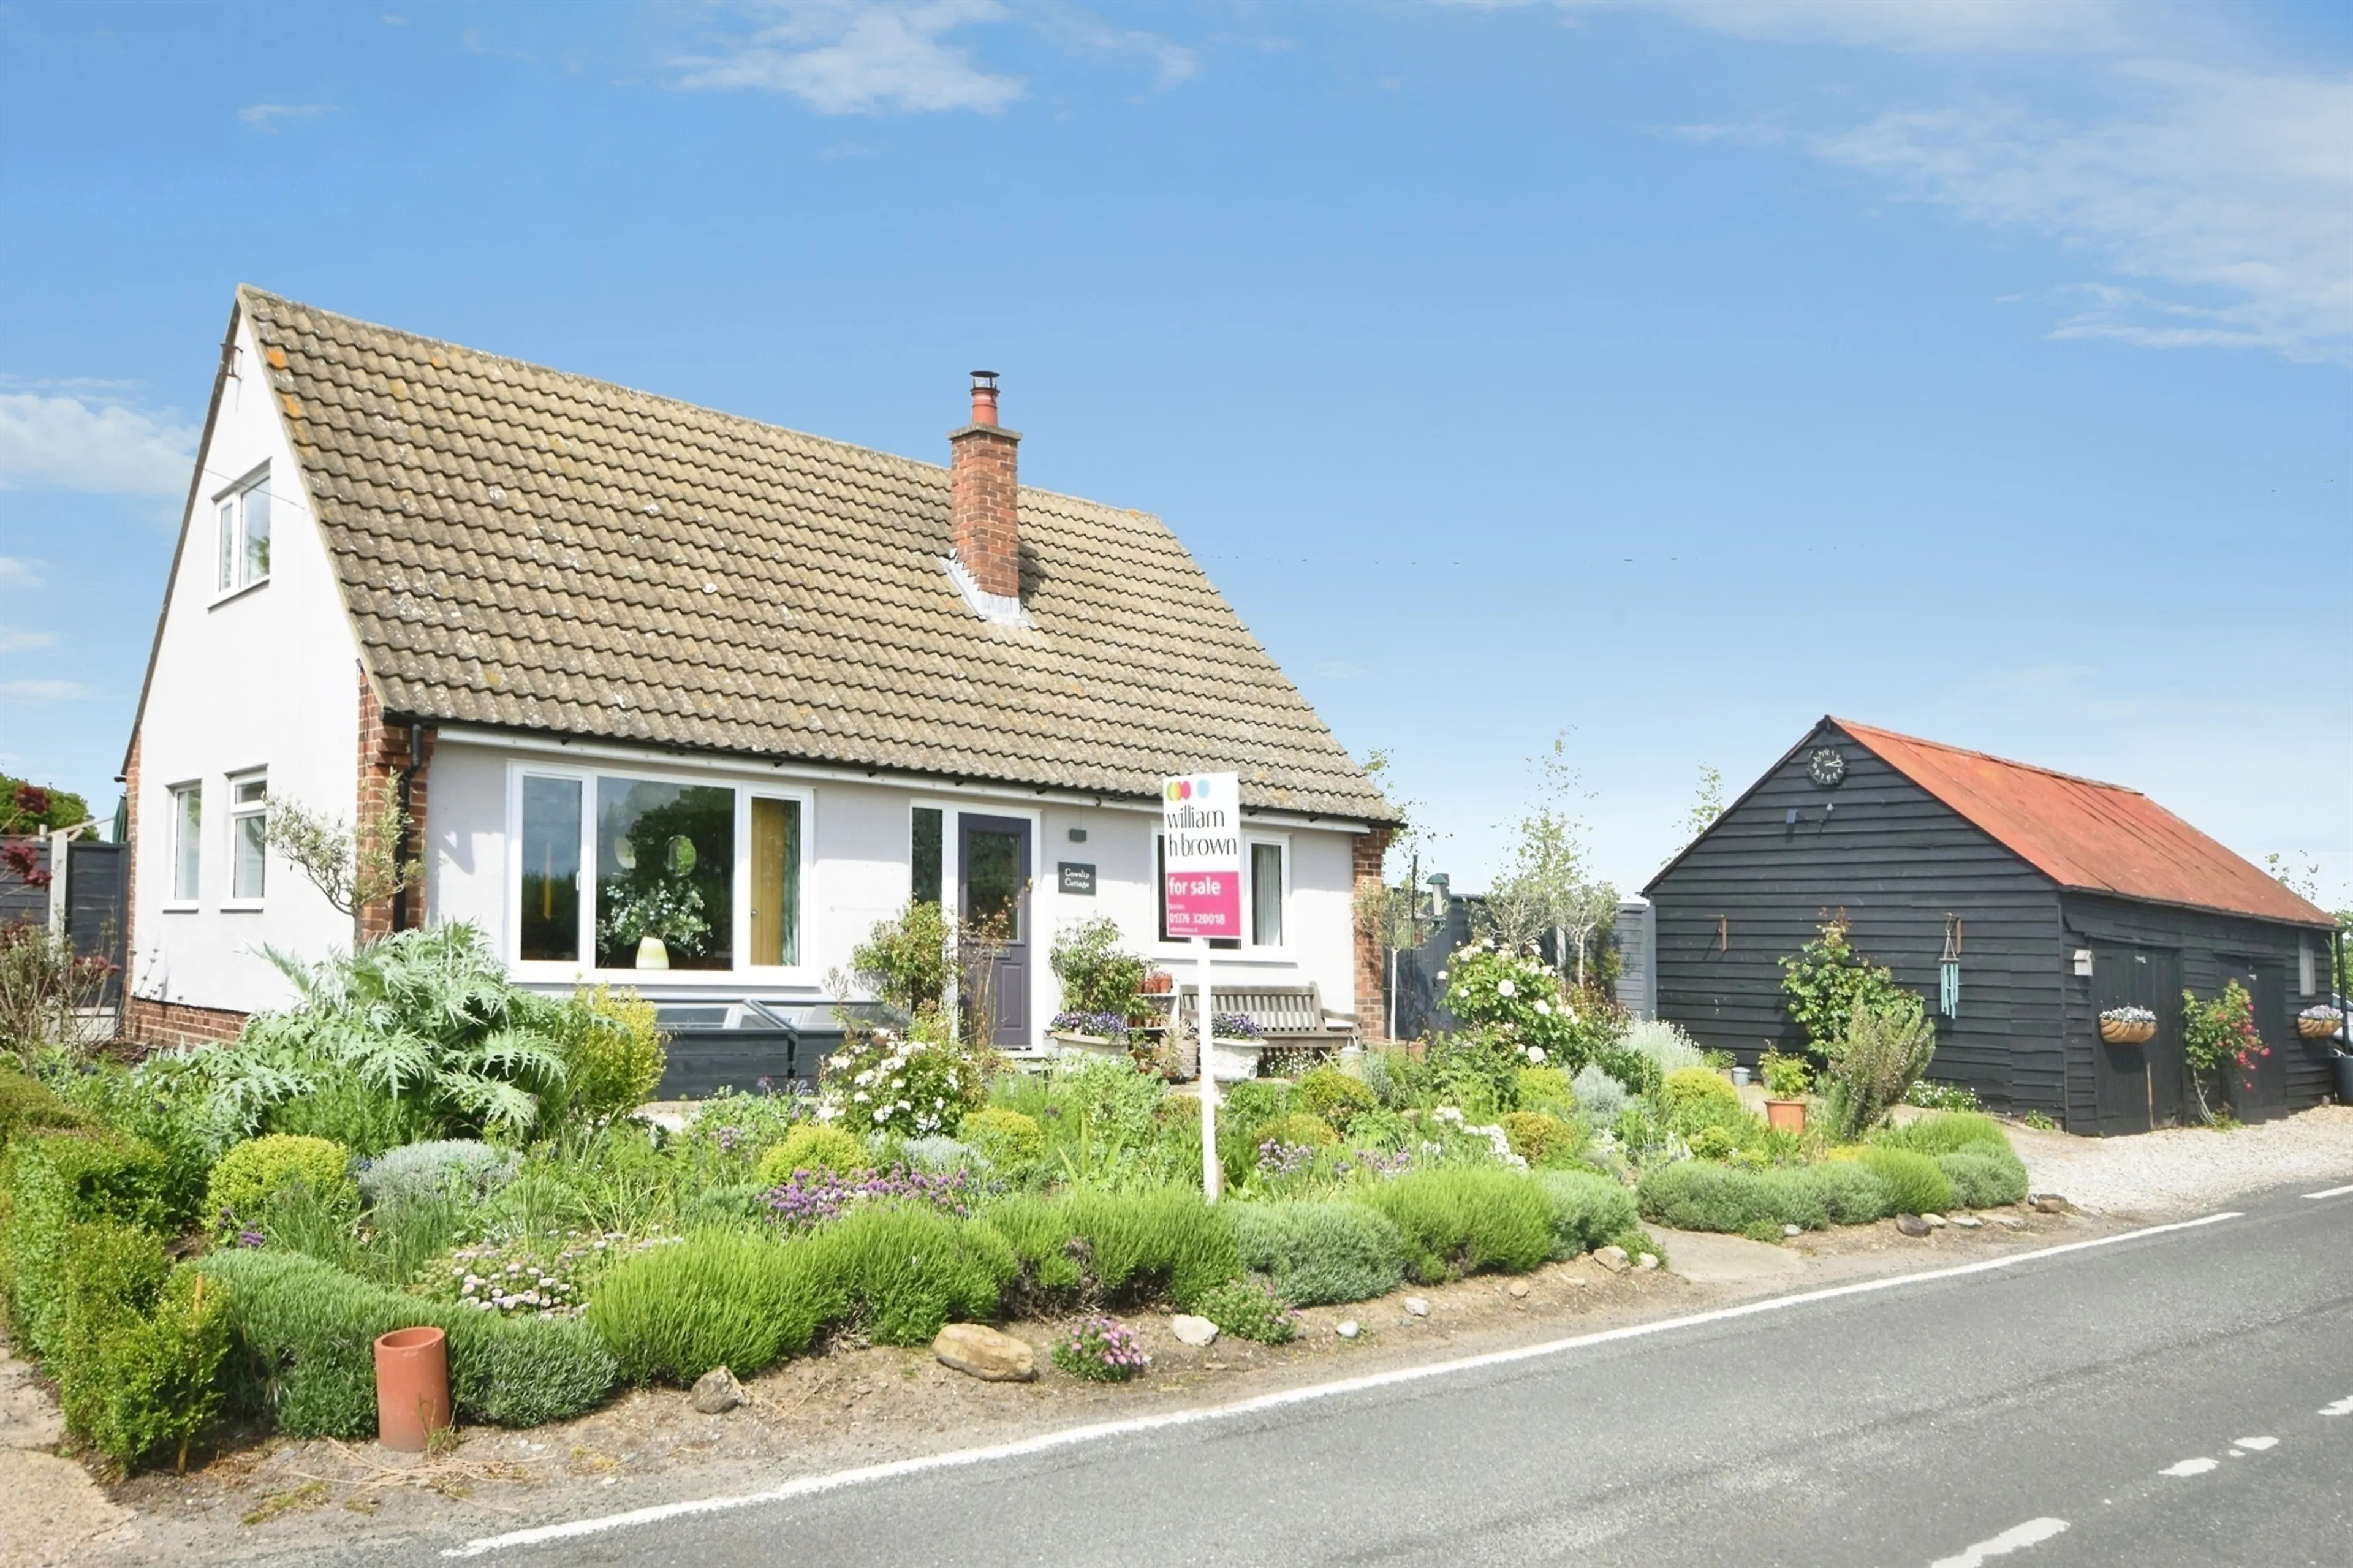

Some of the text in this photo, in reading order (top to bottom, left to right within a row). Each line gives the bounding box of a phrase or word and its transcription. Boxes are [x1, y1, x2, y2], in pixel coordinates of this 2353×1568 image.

[1167, 805, 1225, 829] william
[1169, 833, 1237, 857] h brown
[1065, 868, 1090, 879] Cowslip
[1064, 877, 1090, 889] Cottage
[1169, 876, 1221, 895] for sale
[1169, 912, 1226, 925] 01376 320018
